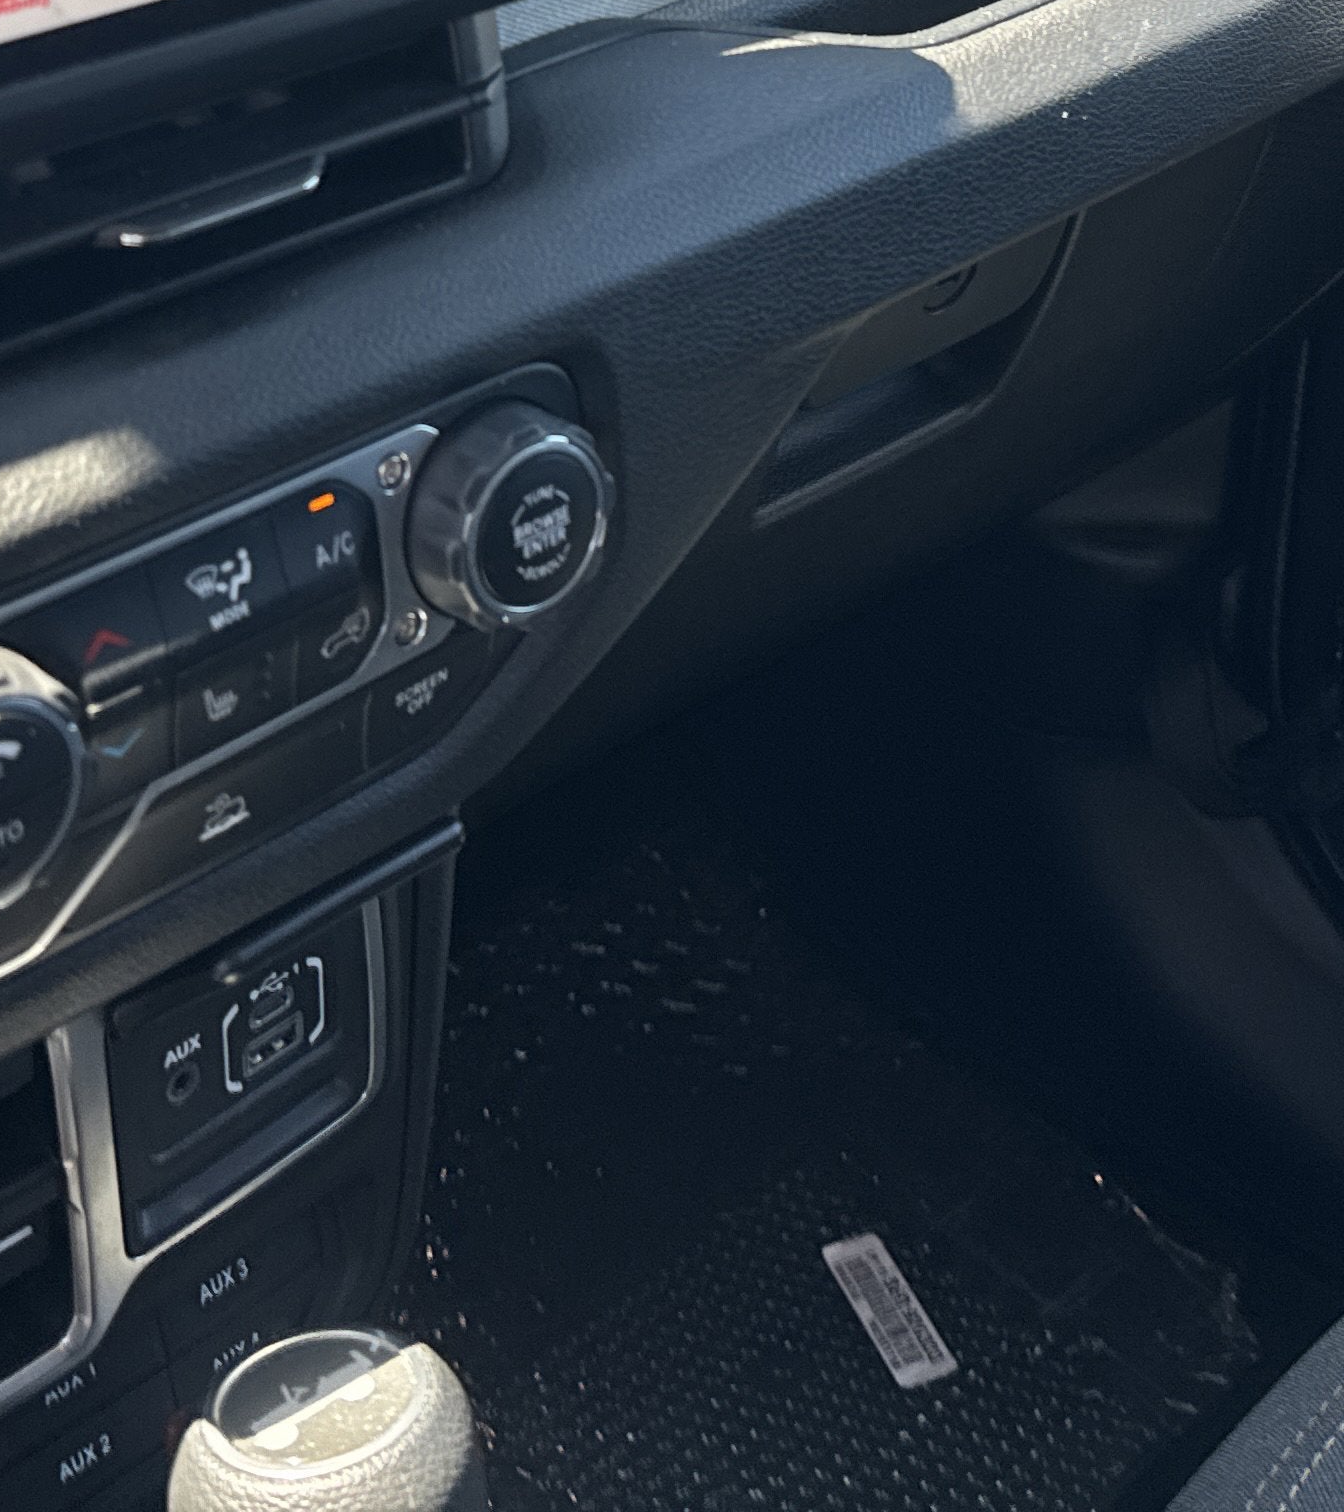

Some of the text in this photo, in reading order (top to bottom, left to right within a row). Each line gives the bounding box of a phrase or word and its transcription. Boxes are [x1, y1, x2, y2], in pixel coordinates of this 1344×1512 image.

[514, 504, 572, 549] BROWSE
[522, 526, 567, 559] ENTER
[315, 530, 356, 569] A/C
[208, 599, 250, 632] MODE
[395, 667, 449, 708] SCREEN
[406, 689, 434, 715] OFF
[164, 1032, 202, 1069] AUX
[199, 1257, 249, 1306] AUX 3
[58, 1433, 113, 1484] AUX 2
